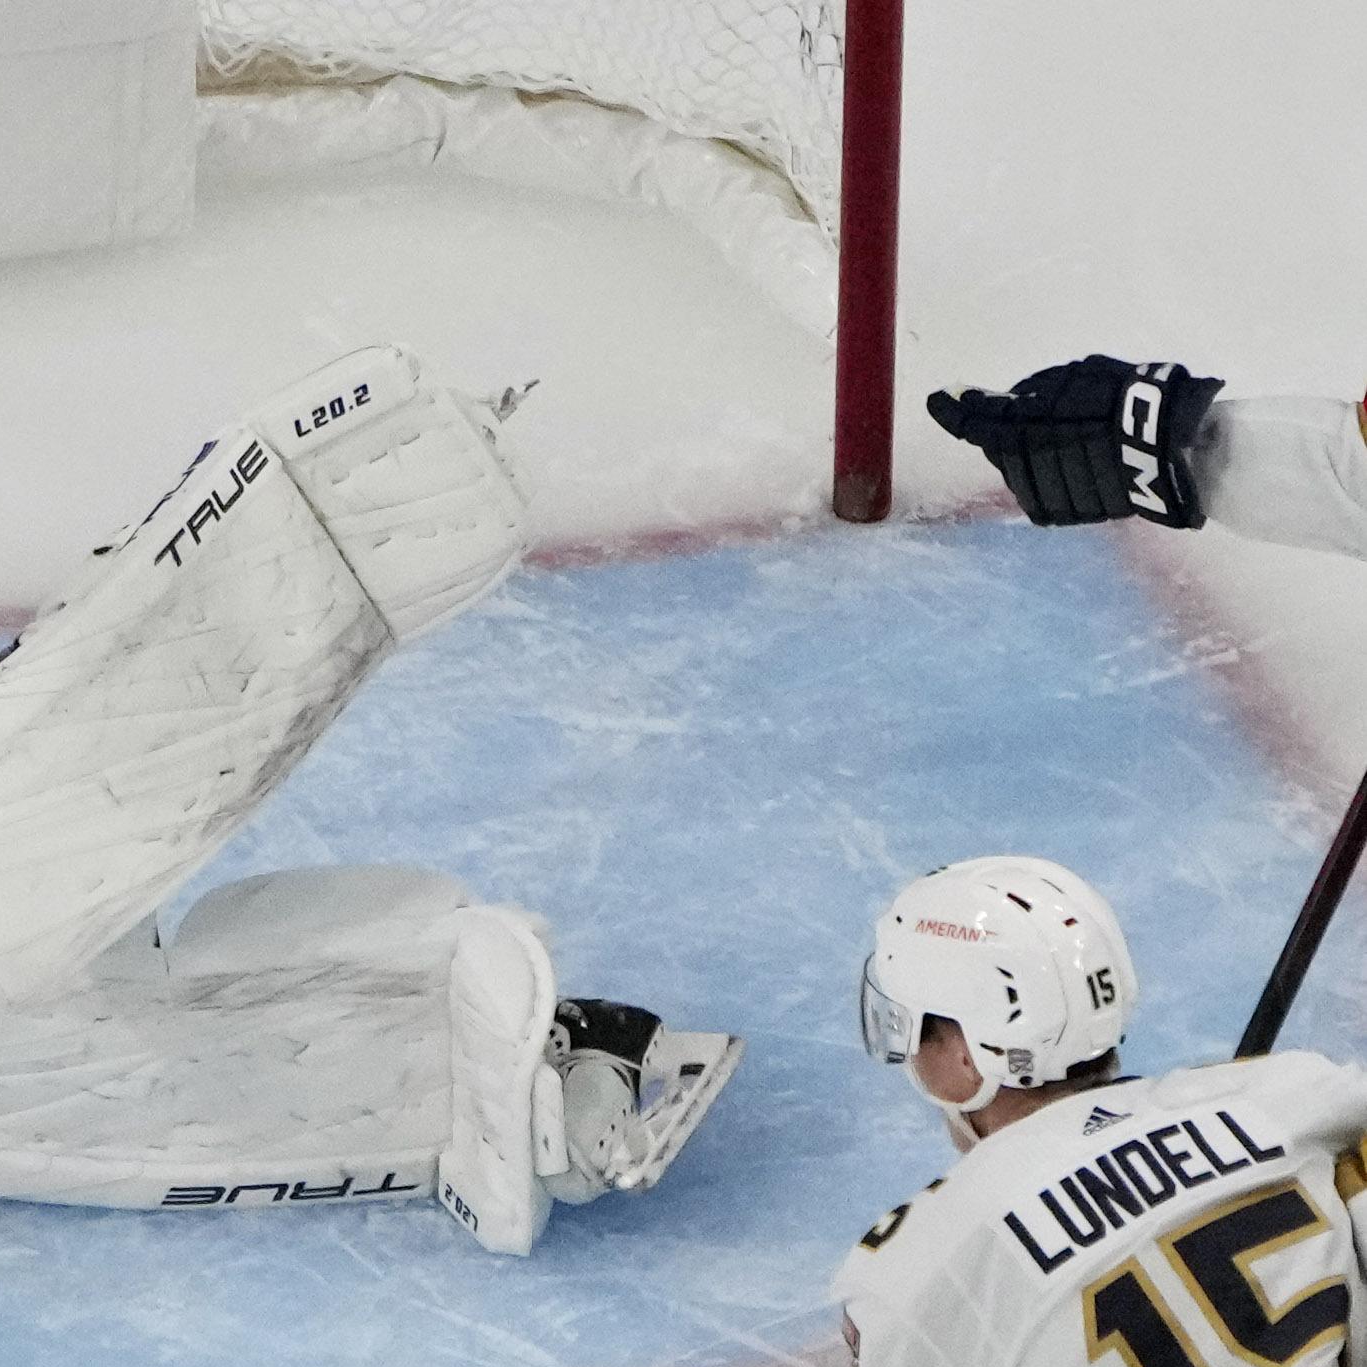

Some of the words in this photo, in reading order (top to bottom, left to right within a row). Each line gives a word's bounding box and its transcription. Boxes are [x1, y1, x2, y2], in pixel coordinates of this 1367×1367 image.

[293, 383, 371, 438] L20.2
[153, 439, 269, 568] TRUE
[1086, 967, 1116, 1010] 15
[163, 1172, 421, 1207] TRUE
[1004, 1111, 1285, 1274] LUNDELL
